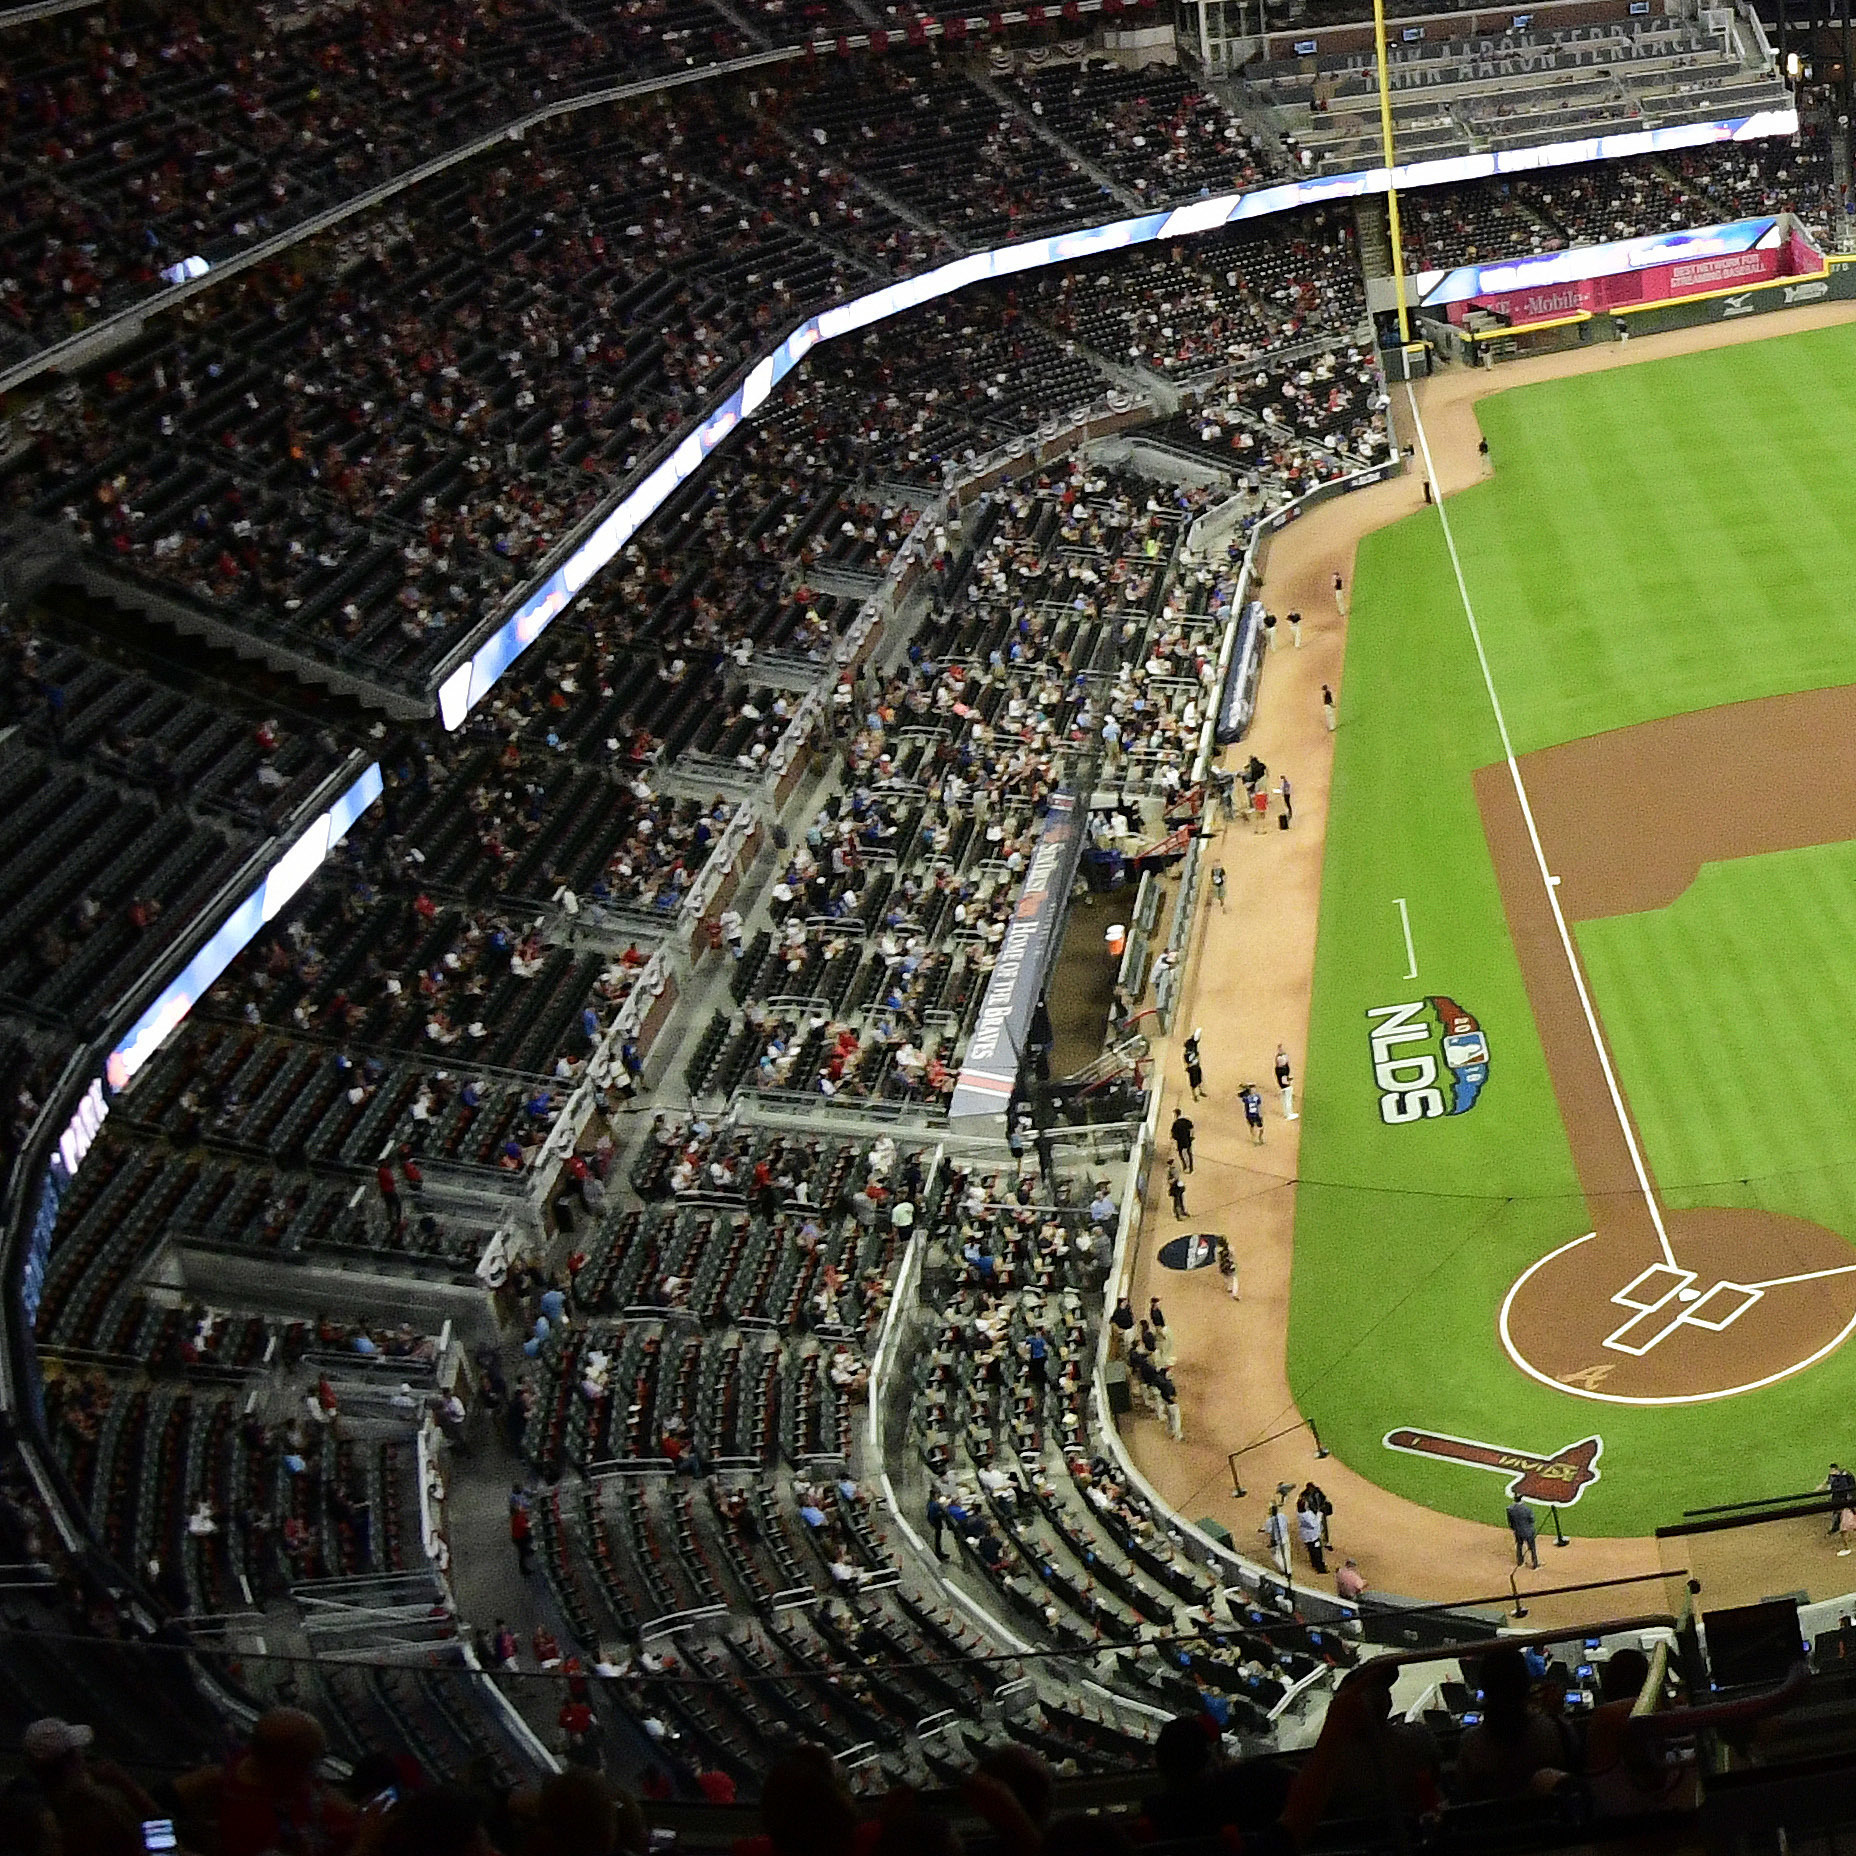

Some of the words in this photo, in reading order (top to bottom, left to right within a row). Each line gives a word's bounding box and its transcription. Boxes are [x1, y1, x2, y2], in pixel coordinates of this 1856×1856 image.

[1002, 921, 1039, 962] HOME
[971, 1006, 1012, 1061] BRAVES
[1367, 1001, 1445, 1125] NLDS
